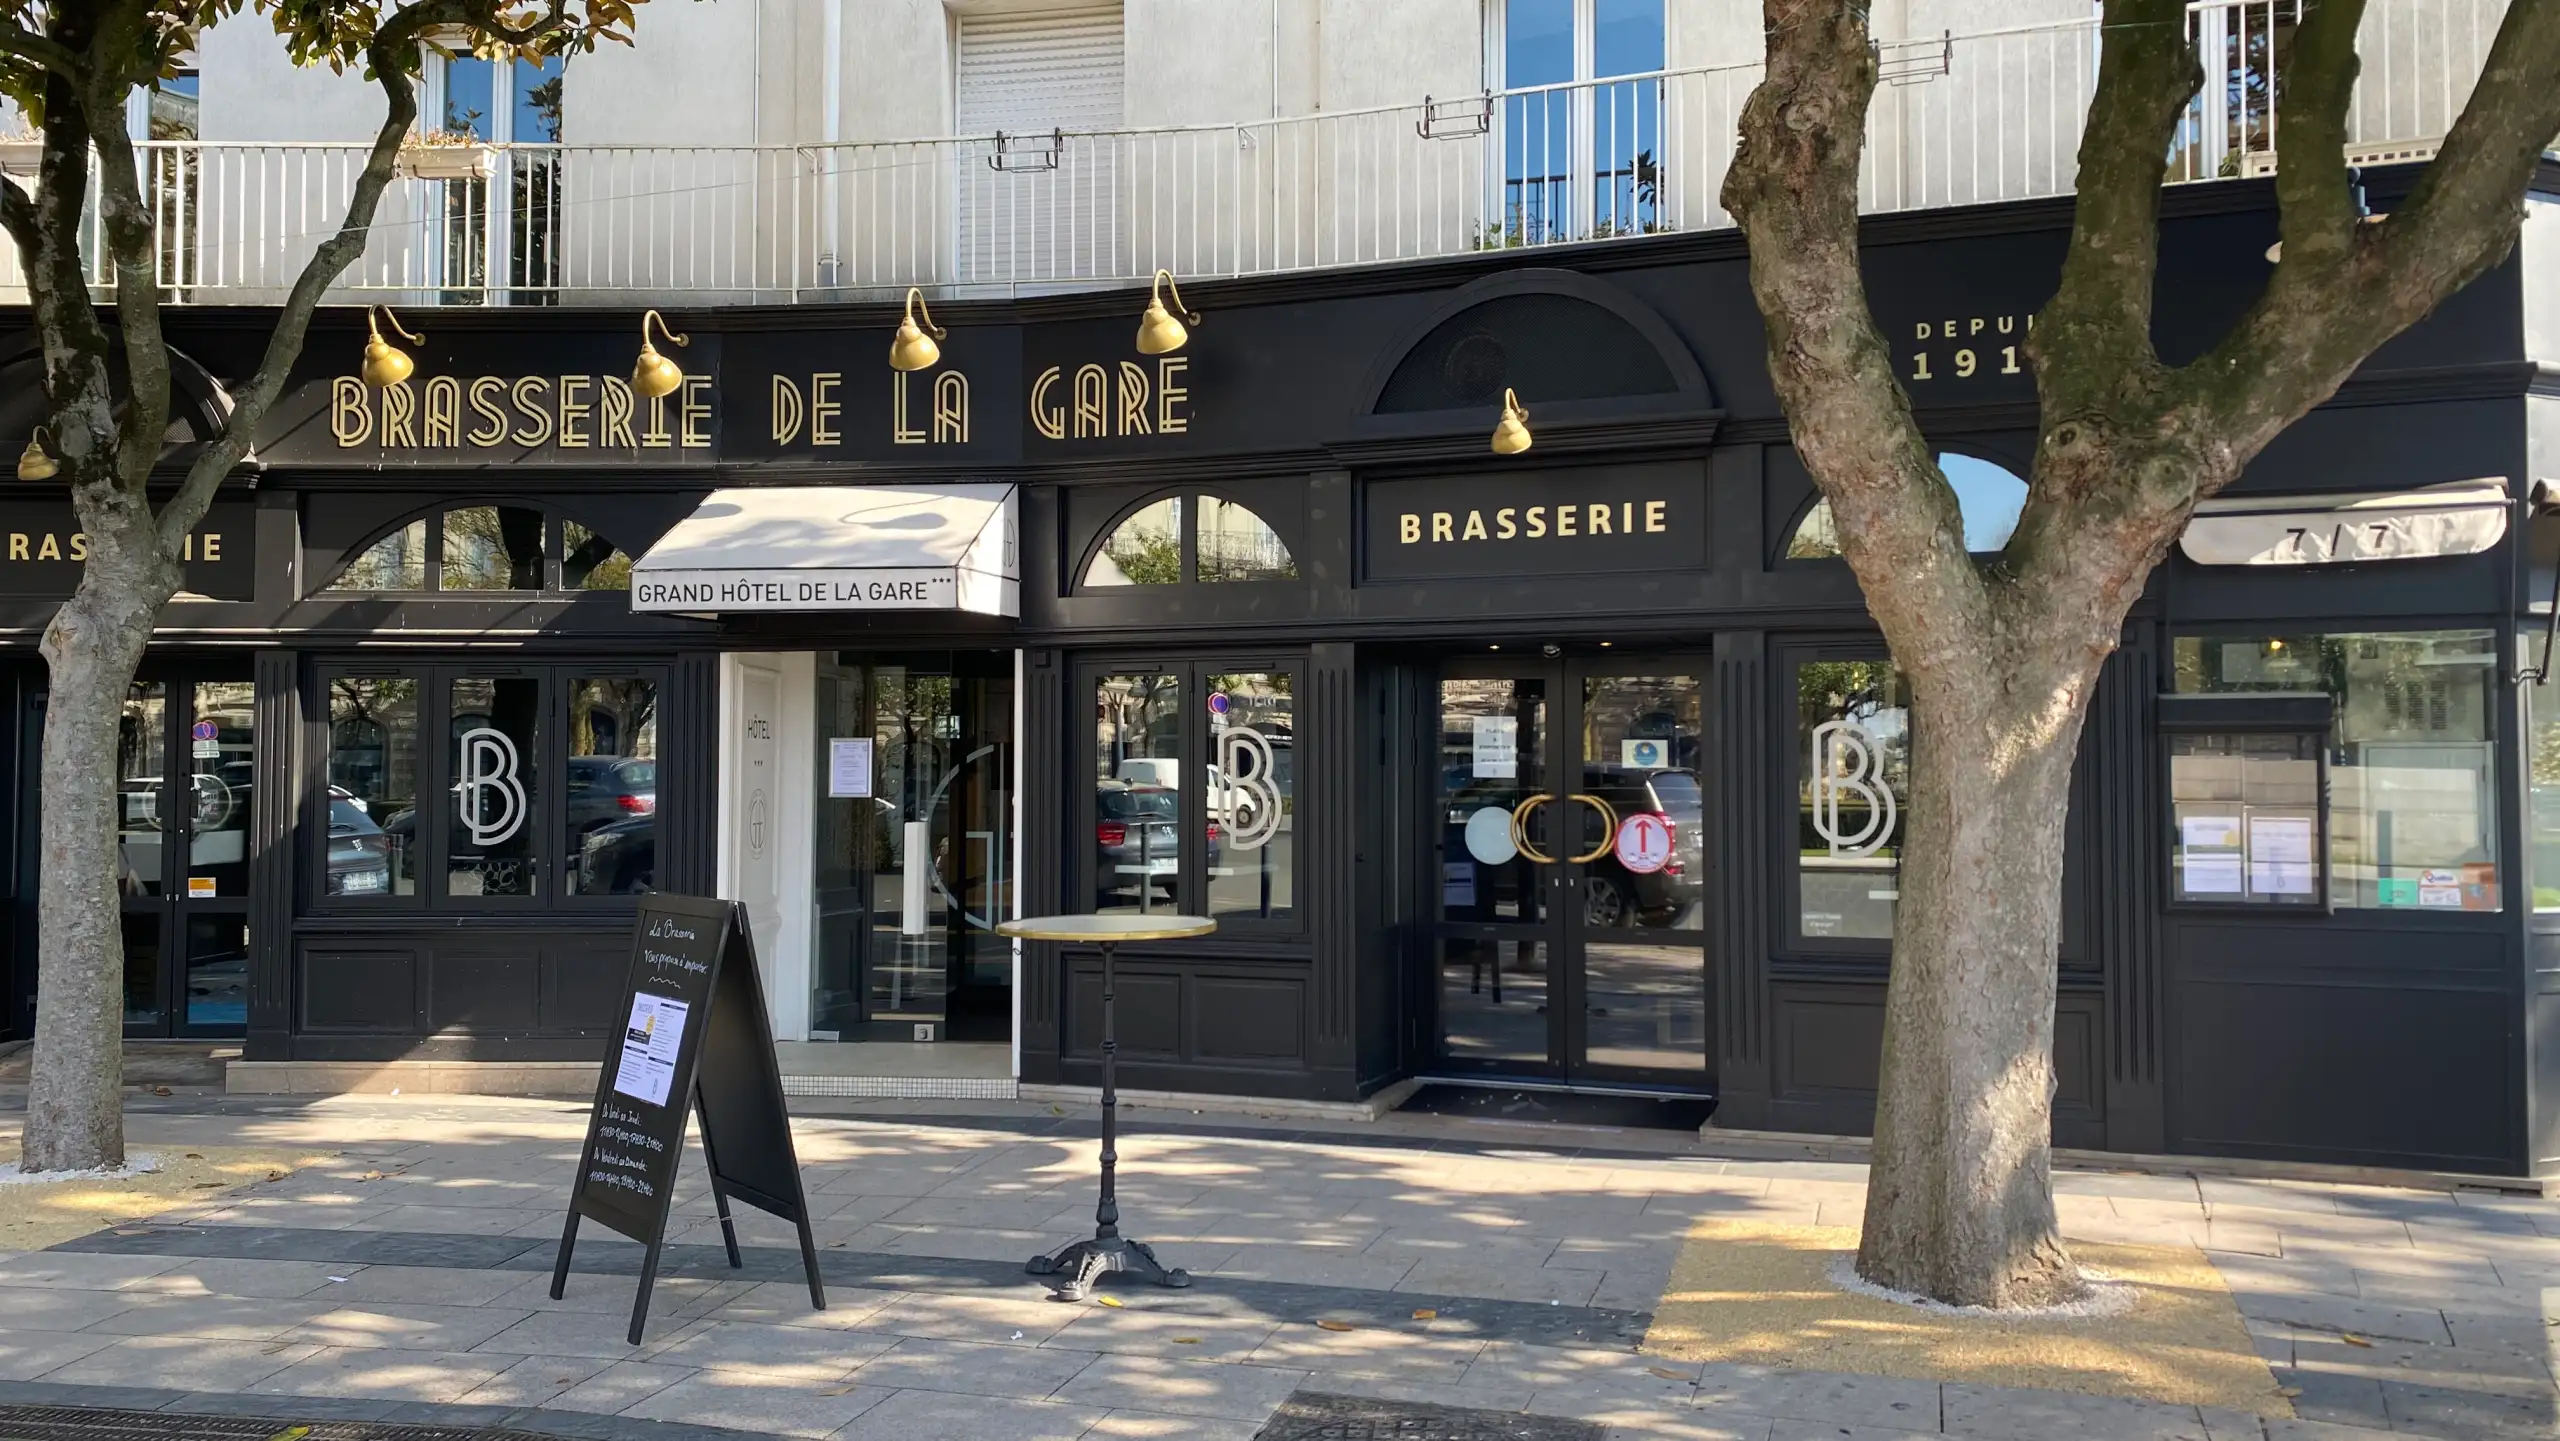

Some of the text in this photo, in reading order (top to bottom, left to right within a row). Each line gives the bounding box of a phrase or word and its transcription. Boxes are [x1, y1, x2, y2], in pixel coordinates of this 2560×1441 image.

[1916, 314, 2035, 340] DEPUI
[1912, 345, 2022, 380] 191
[331, 356, 1188, 449] BRASSERIE DE LA GARE
[1400, 500, 1667, 544] BRASSERIE
[0, 532, 222, 562] RASIE
[638, 578, 928, 603] GRAND HÔTEL DE LA GARE
[747, 714, 771, 740] HÔTEL
[649, 917, 661, 937] La
